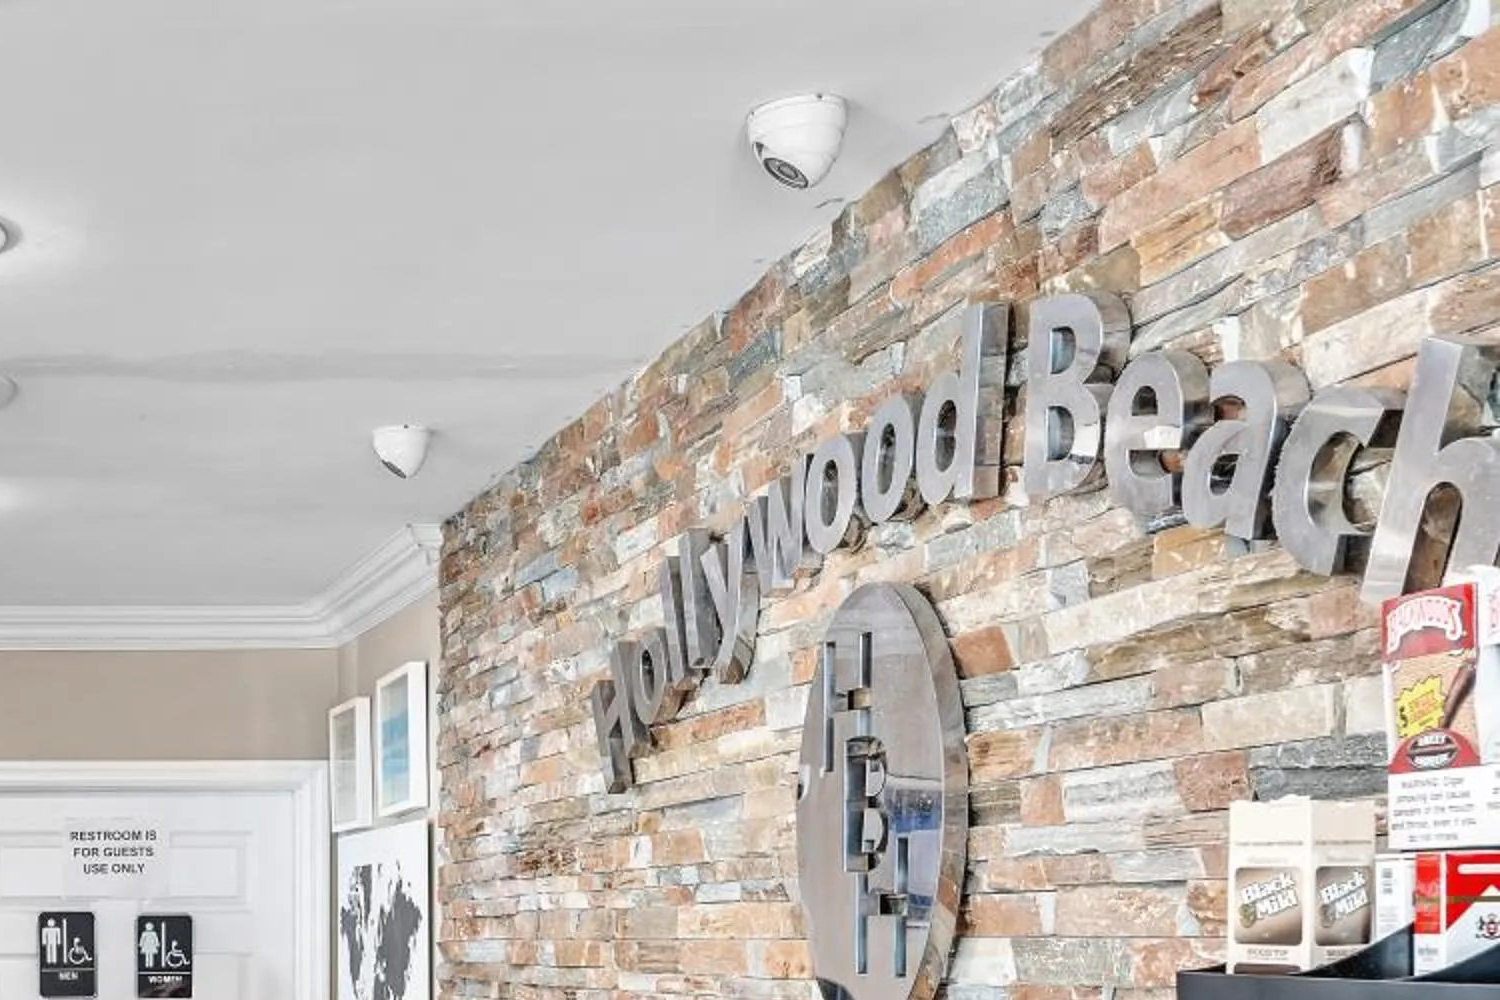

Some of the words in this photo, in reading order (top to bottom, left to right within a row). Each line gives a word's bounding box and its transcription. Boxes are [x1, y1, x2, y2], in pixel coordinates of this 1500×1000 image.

[592, 302, 1009, 793] Hollywood
[1025, 293, 1500, 602] Beach
[70, 830, 142, 841] RESTROOM
[145, 829, 157, 841] IS
[73, 847, 100, 858] FOR
[103, 846, 155, 857] GUESTS
[83, 863, 108, 875] USE
[111, 863, 145, 874] ONLY
[1241, 870, 1296, 904] Black
[1320, 869, 1367, 905] Black
[1256, 889, 1299, 919] Mild
[1335, 888, 1370, 919] Mild
[59, 970, 79, 981] MEN
[148, 975, 183, 984] WOMEN
